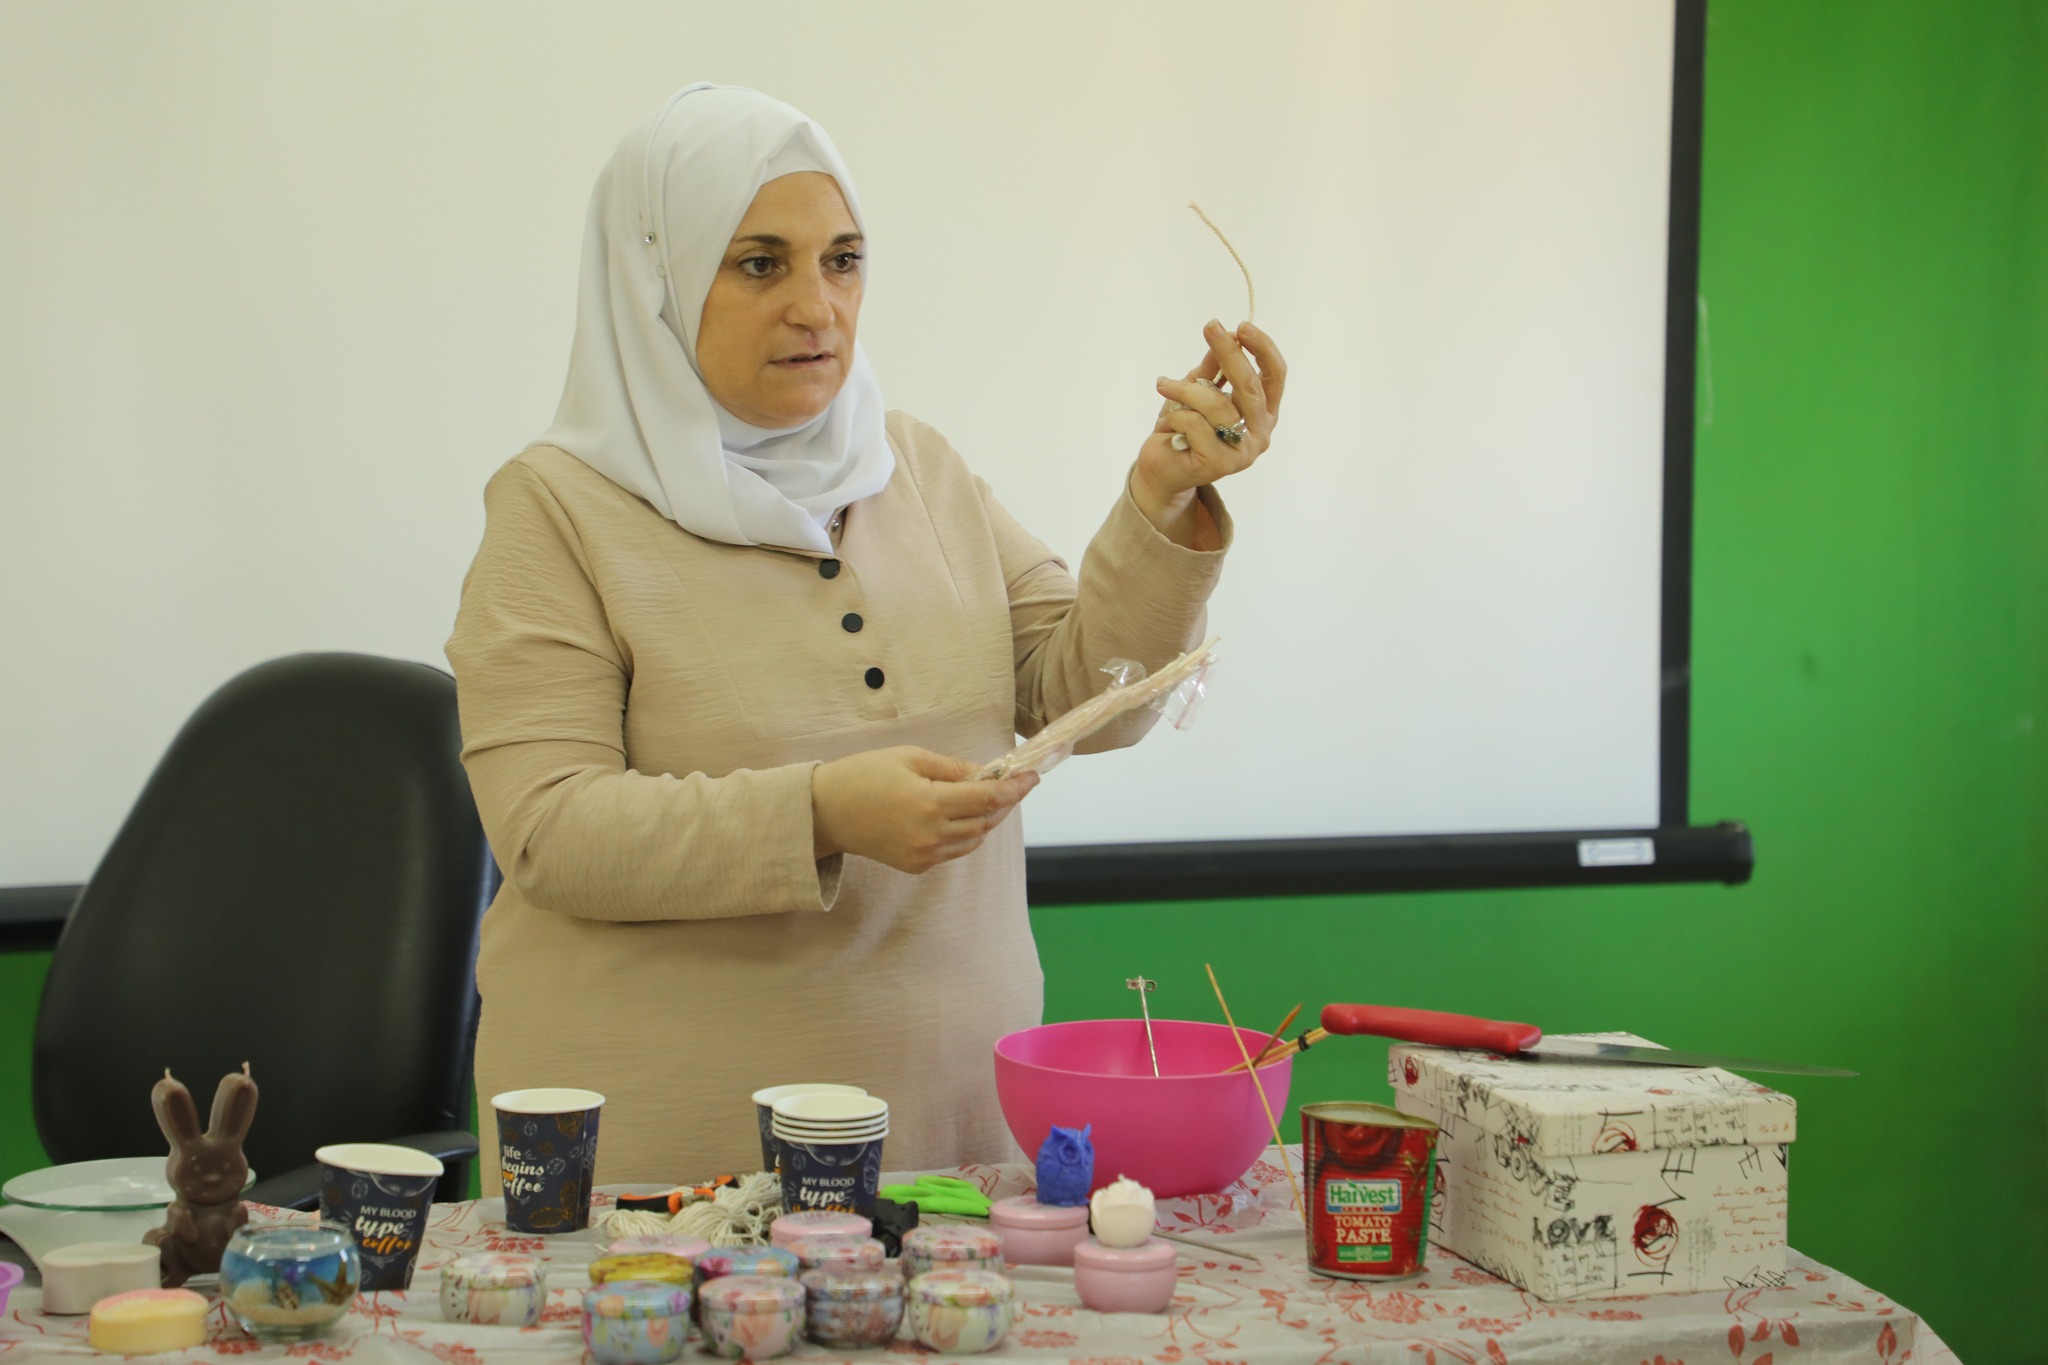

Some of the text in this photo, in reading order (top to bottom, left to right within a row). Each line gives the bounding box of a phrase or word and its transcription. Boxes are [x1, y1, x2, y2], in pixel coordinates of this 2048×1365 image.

[503, 1144, 522, 1160] life
[802, 1177, 855, 1187] MY BLOOD
[799, 1186, 846, 1208] type
[1330, 1184, 1396, 1204] Harvest
[360, 1205, 417, 1219] MY BLOOD
[355, 1216, 405, 1238] type
[1334, 1215, 1393, 1228] TOMATO
[1335, 1227, 1393, 1244] PASTE
[362, 1236, 411, 1254] coffee
